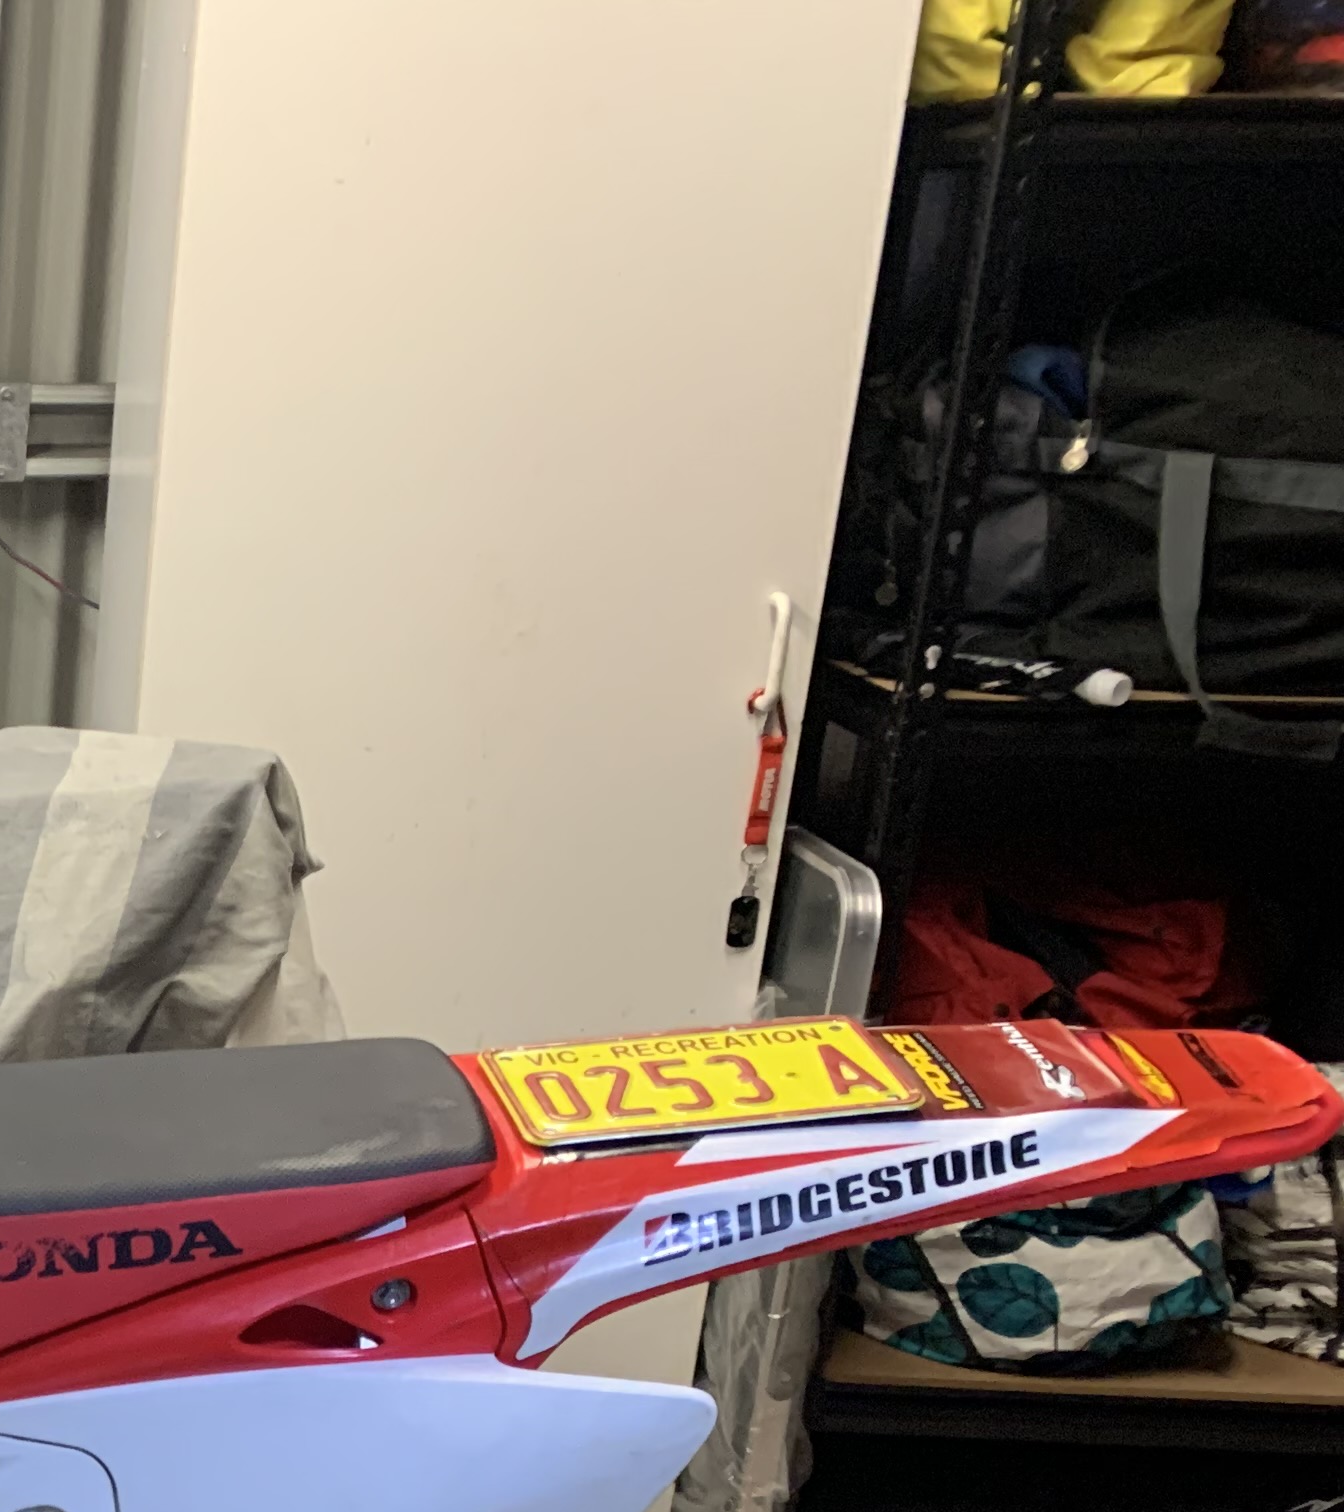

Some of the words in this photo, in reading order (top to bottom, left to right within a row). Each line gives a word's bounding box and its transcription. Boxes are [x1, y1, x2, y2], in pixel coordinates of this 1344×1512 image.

[524, 1050, 579, 1067] VIC
[610, 1027, 822, 1059] RECREATION
[524, 1054, 776, 1121] 0253
[817, 1043, 890, 1097] A
[641, 1130, 1041, 1266] BRIDGESTONE
